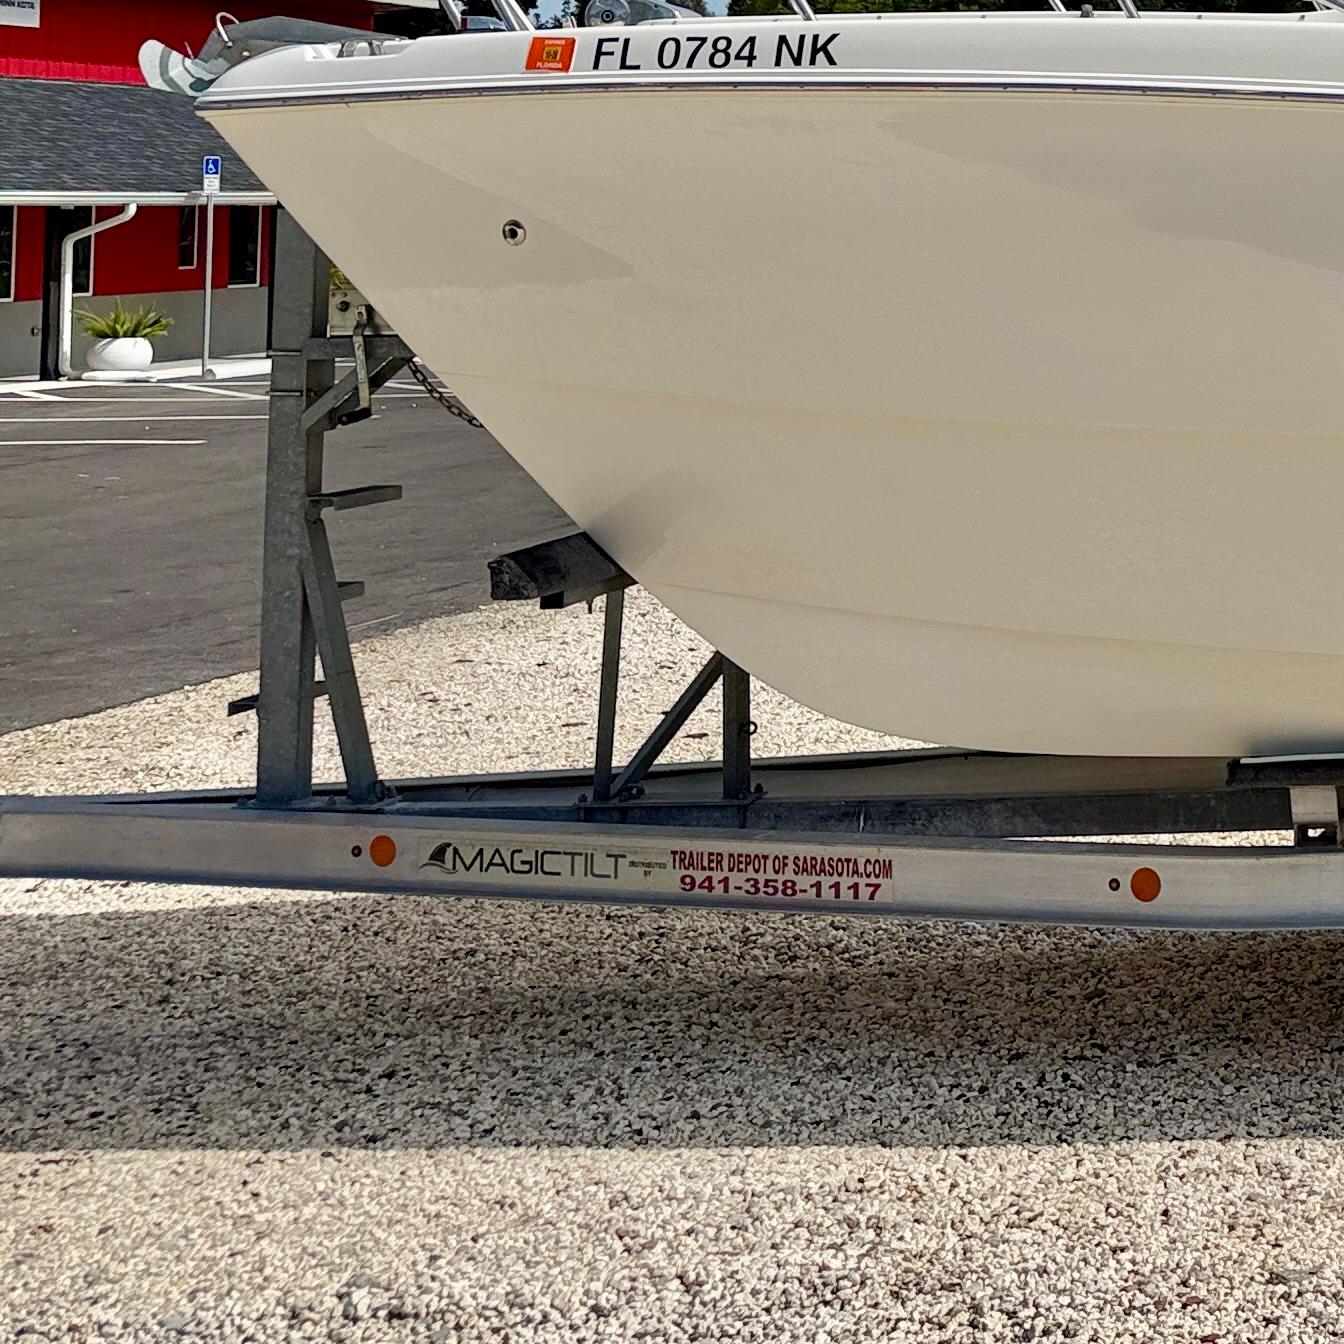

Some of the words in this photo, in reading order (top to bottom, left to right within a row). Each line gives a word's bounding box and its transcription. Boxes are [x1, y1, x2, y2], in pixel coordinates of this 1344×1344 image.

[591, 36, 641, 71] FL
[657, 35, 758, 70] 0784
[774, 32, 841, 68] NK
[452, 845, 628, 880] MAGICTILT
[670, 850, 724, 873] TRAILER
[727, 853, 769, 875] DEPOT
[772, 855, 789, 876] OF
[792, 855, 893, 880] SARASOTA.COM
[679, 873, 883, 901] 941-358-1117
